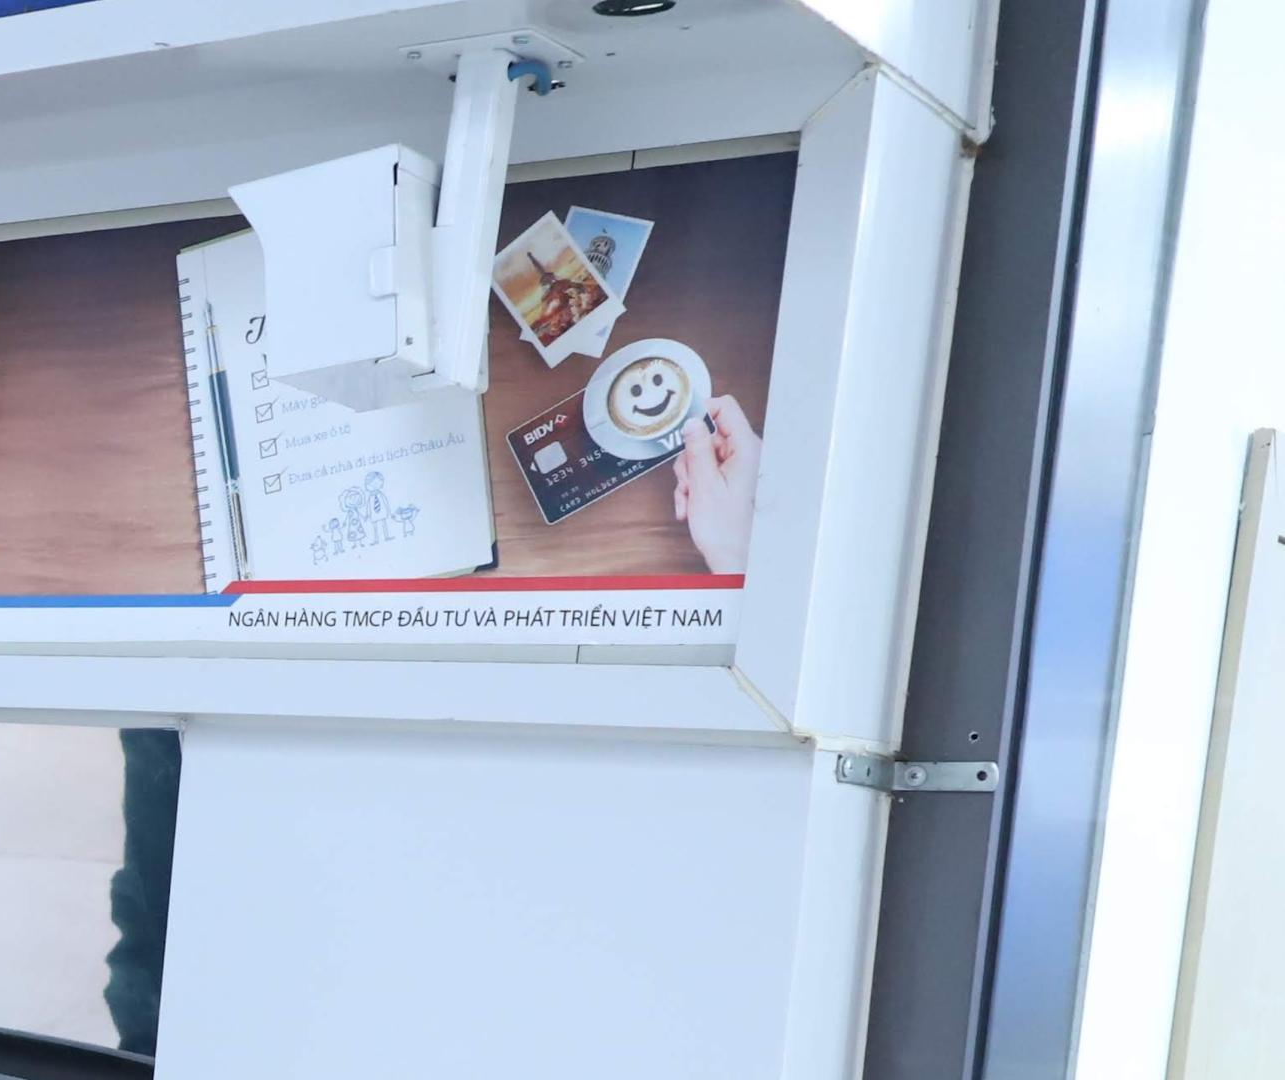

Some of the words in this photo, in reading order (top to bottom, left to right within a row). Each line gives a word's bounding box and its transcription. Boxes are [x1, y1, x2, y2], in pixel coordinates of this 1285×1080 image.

[523, 418, 555, 446] BIDV
[544, 465, 575, 487] 1234
[227, 608, 280, 627] NGÂN
[284, 608, 337, 627] HÀNG
[342, 610, 393, 627] TMCP
[397, 606, 439, 627] ĐẦU
[443, 608, 470, 627] TƯ
[474, 608, 498, 627] VÀ
[503, 606, 555, 627] PHÁT
[559, 604, 617, 627] TRIỂN
[622, 606, 667, 629] VIỆT
[671, 609, 723, 627] NAM
